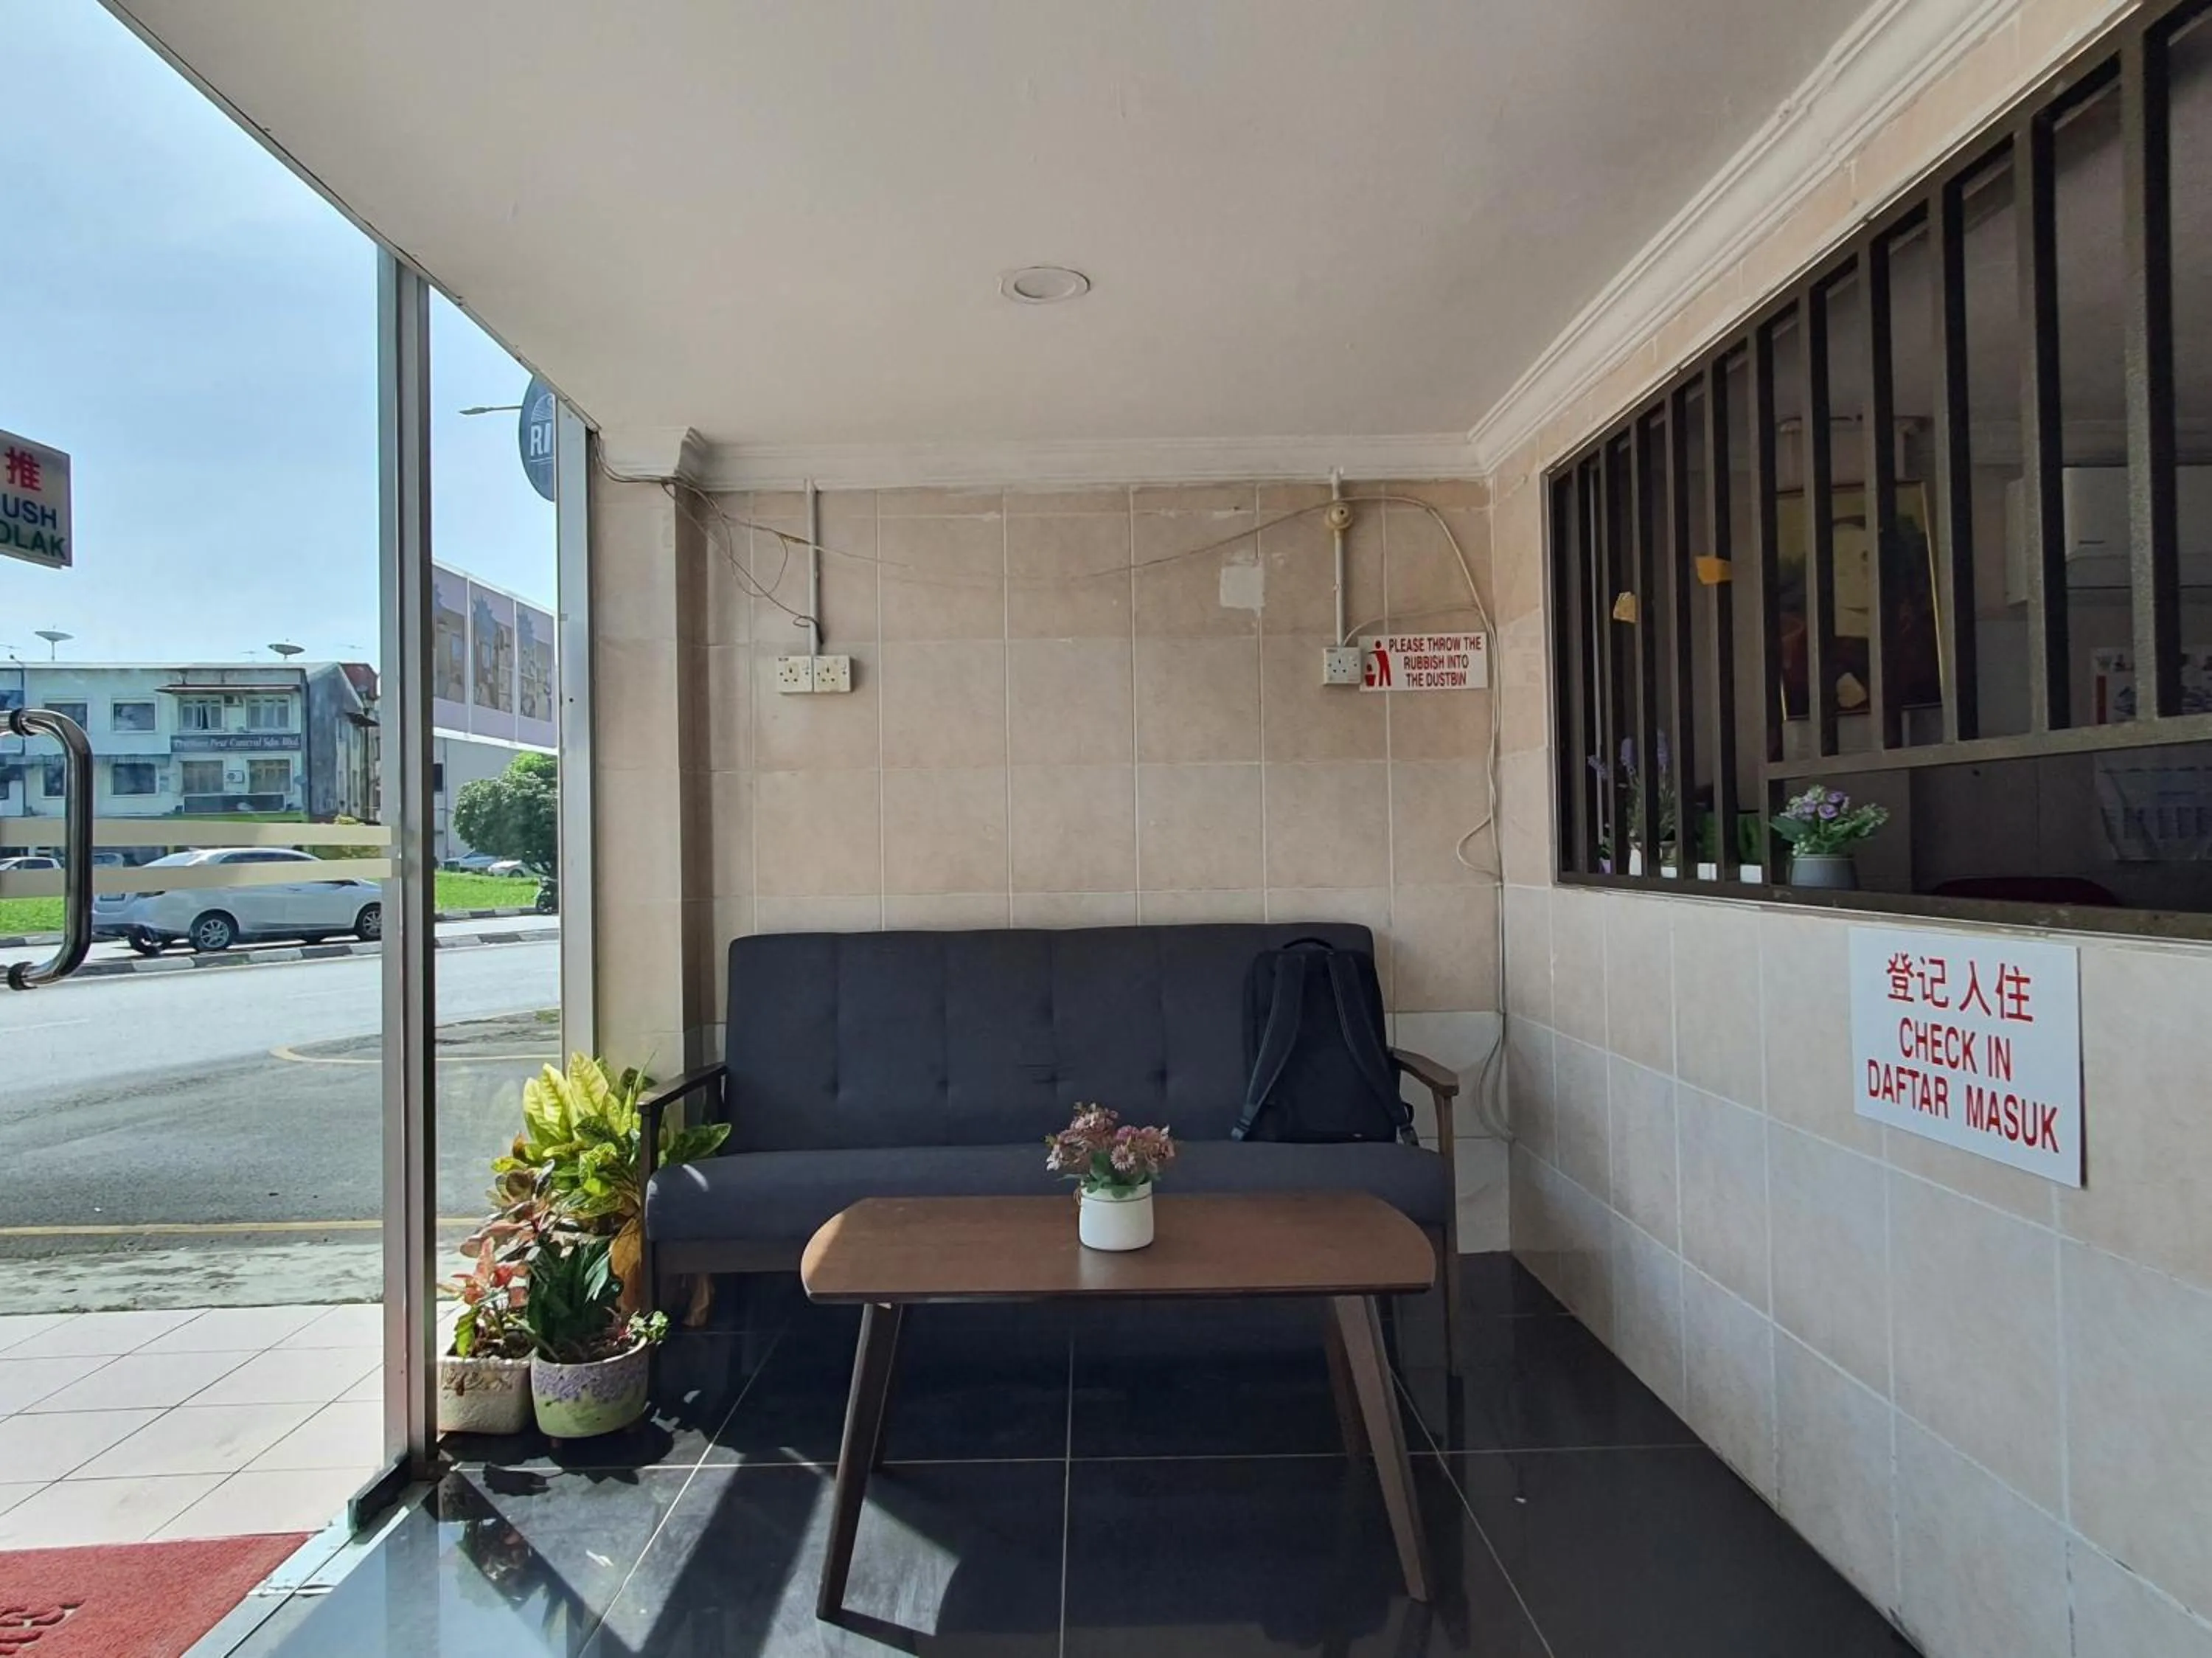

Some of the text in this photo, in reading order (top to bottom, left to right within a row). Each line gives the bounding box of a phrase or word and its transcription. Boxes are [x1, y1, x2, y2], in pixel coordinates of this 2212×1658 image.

[4, 446, 42, 492] 推
[1389, 637, 1481, 652] PLEASE THROW THE
[1403, 654, 1469, 670] RUBBISH INTO
[1405, 672, 1467, 687] THE DUSTBIN
[1885, 952, 2034, 1022] 登记入住
[1899, 1017, 2011, 1082] CHECK IN
[1867, 1058, 2059, 1153] DAFTAR MASUK
